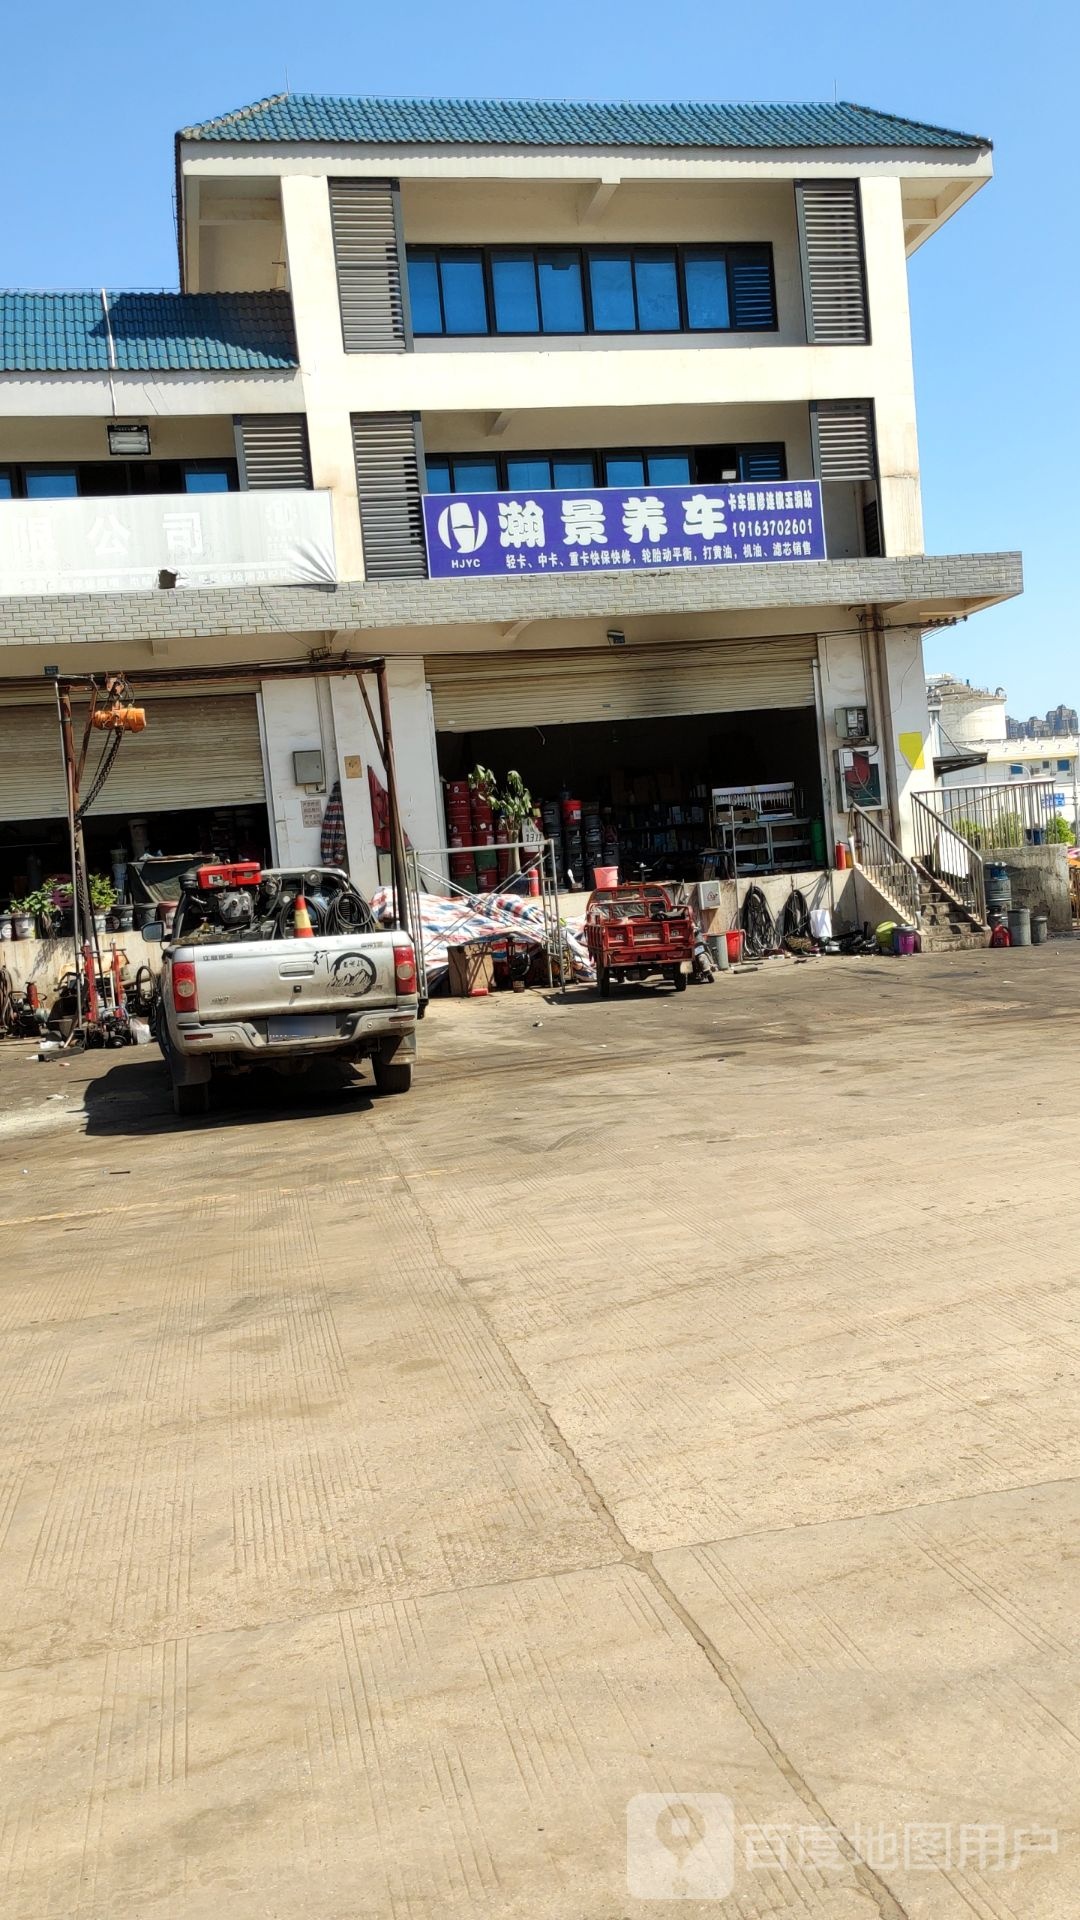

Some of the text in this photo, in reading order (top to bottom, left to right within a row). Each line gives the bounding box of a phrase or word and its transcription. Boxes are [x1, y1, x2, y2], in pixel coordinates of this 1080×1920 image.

[498, 494, 728, 548] 瀚景养车
[732, 518, 813, 538] 19163702601
[451, 558, 481, 569] HJYC
